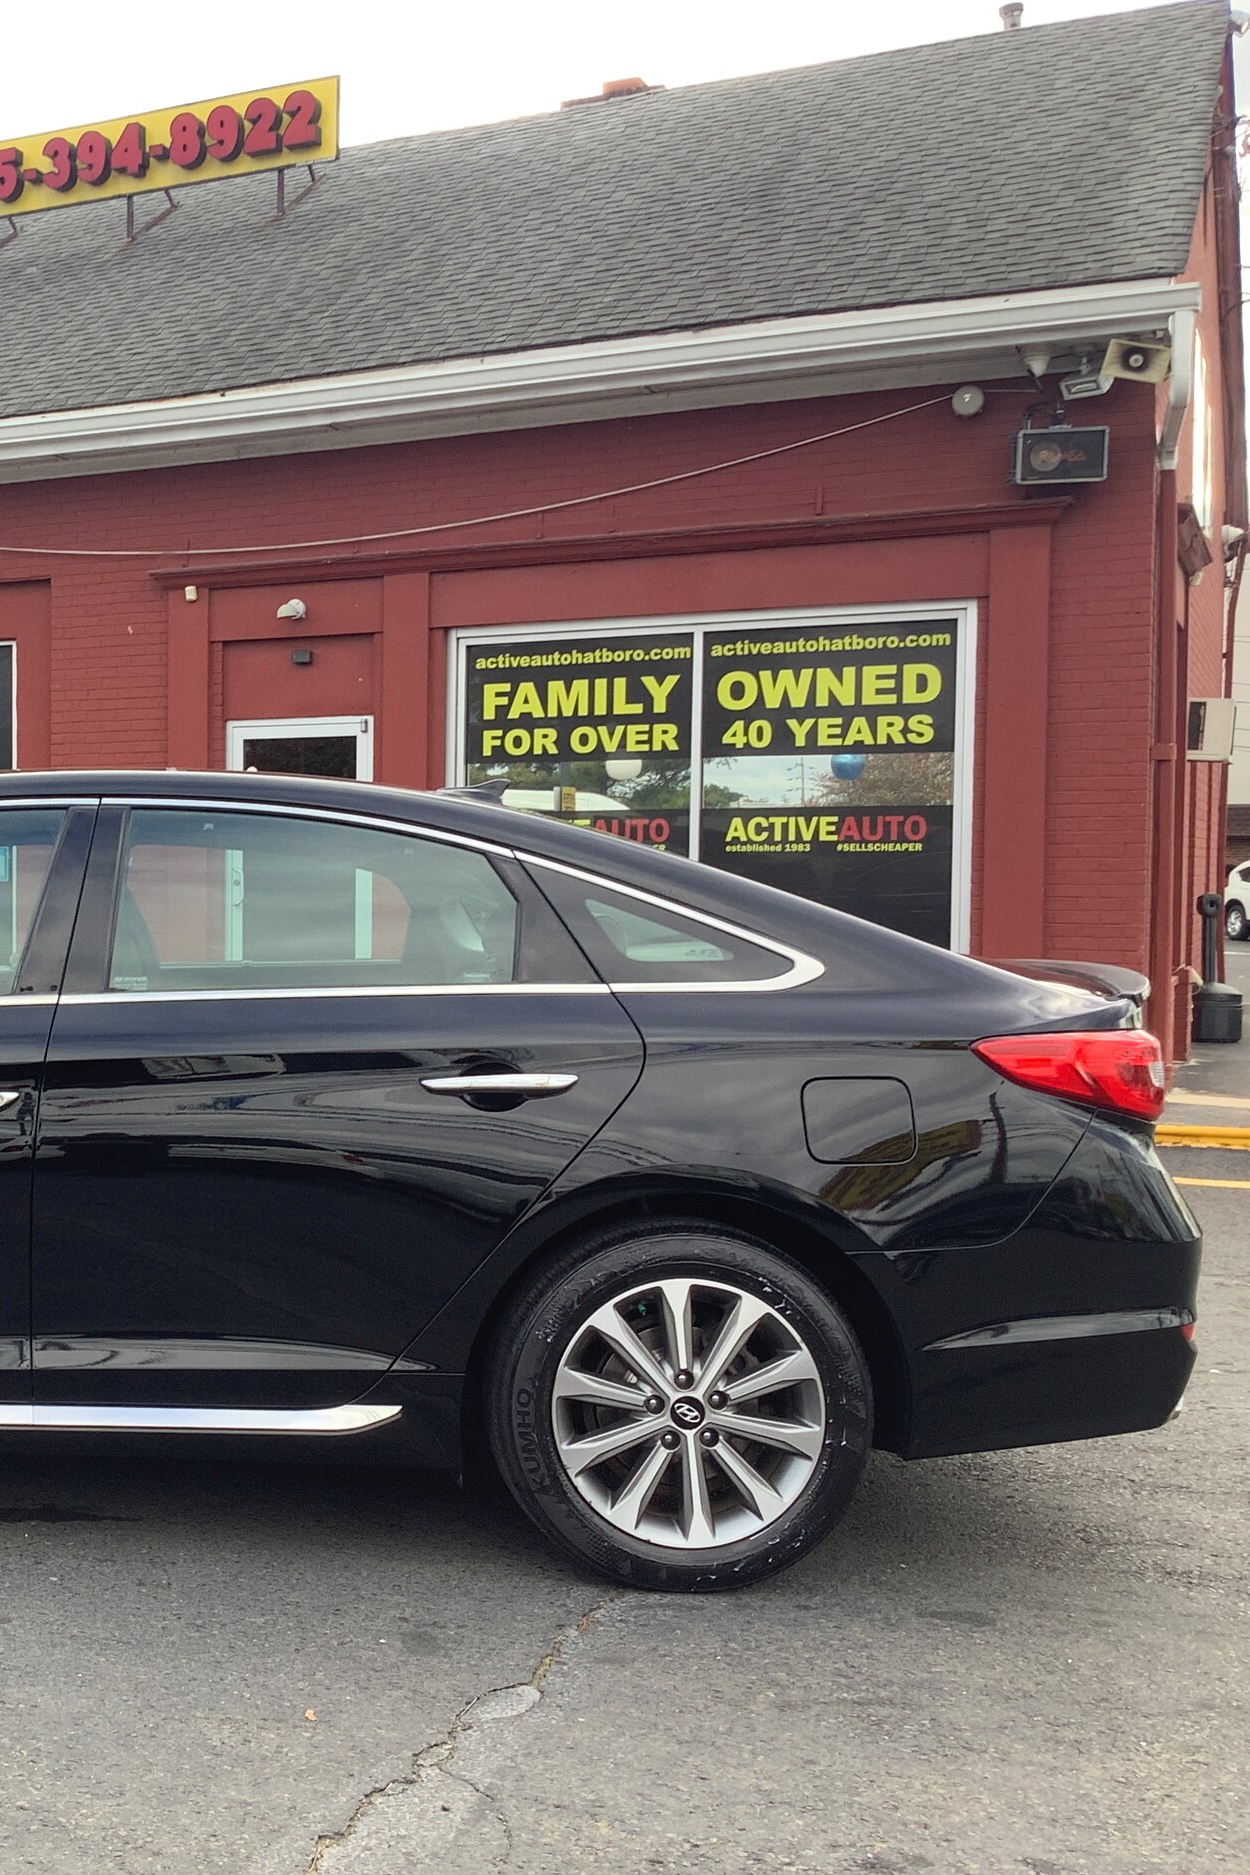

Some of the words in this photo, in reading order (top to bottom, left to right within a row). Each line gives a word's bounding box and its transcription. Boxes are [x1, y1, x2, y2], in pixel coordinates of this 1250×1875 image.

[475, 645, 692, 670] activeautohatboro.com
[711, 632, 951, 657] activeautohatboro.com
[482, 674, 681, 720] FAMILY
[716, 662, 943, 711] OWNED
[482, 728, 559, 757] FOR
[569, 723, 680, 755] OVER
[722, 719, 773, 749] 40
[785, 714, 935, 748] YEARS
[725, 843, 782, 853] established
[783, 843, 811, 853] 1983
[836, 842, 923, 852] #SELLSCHEAPER
